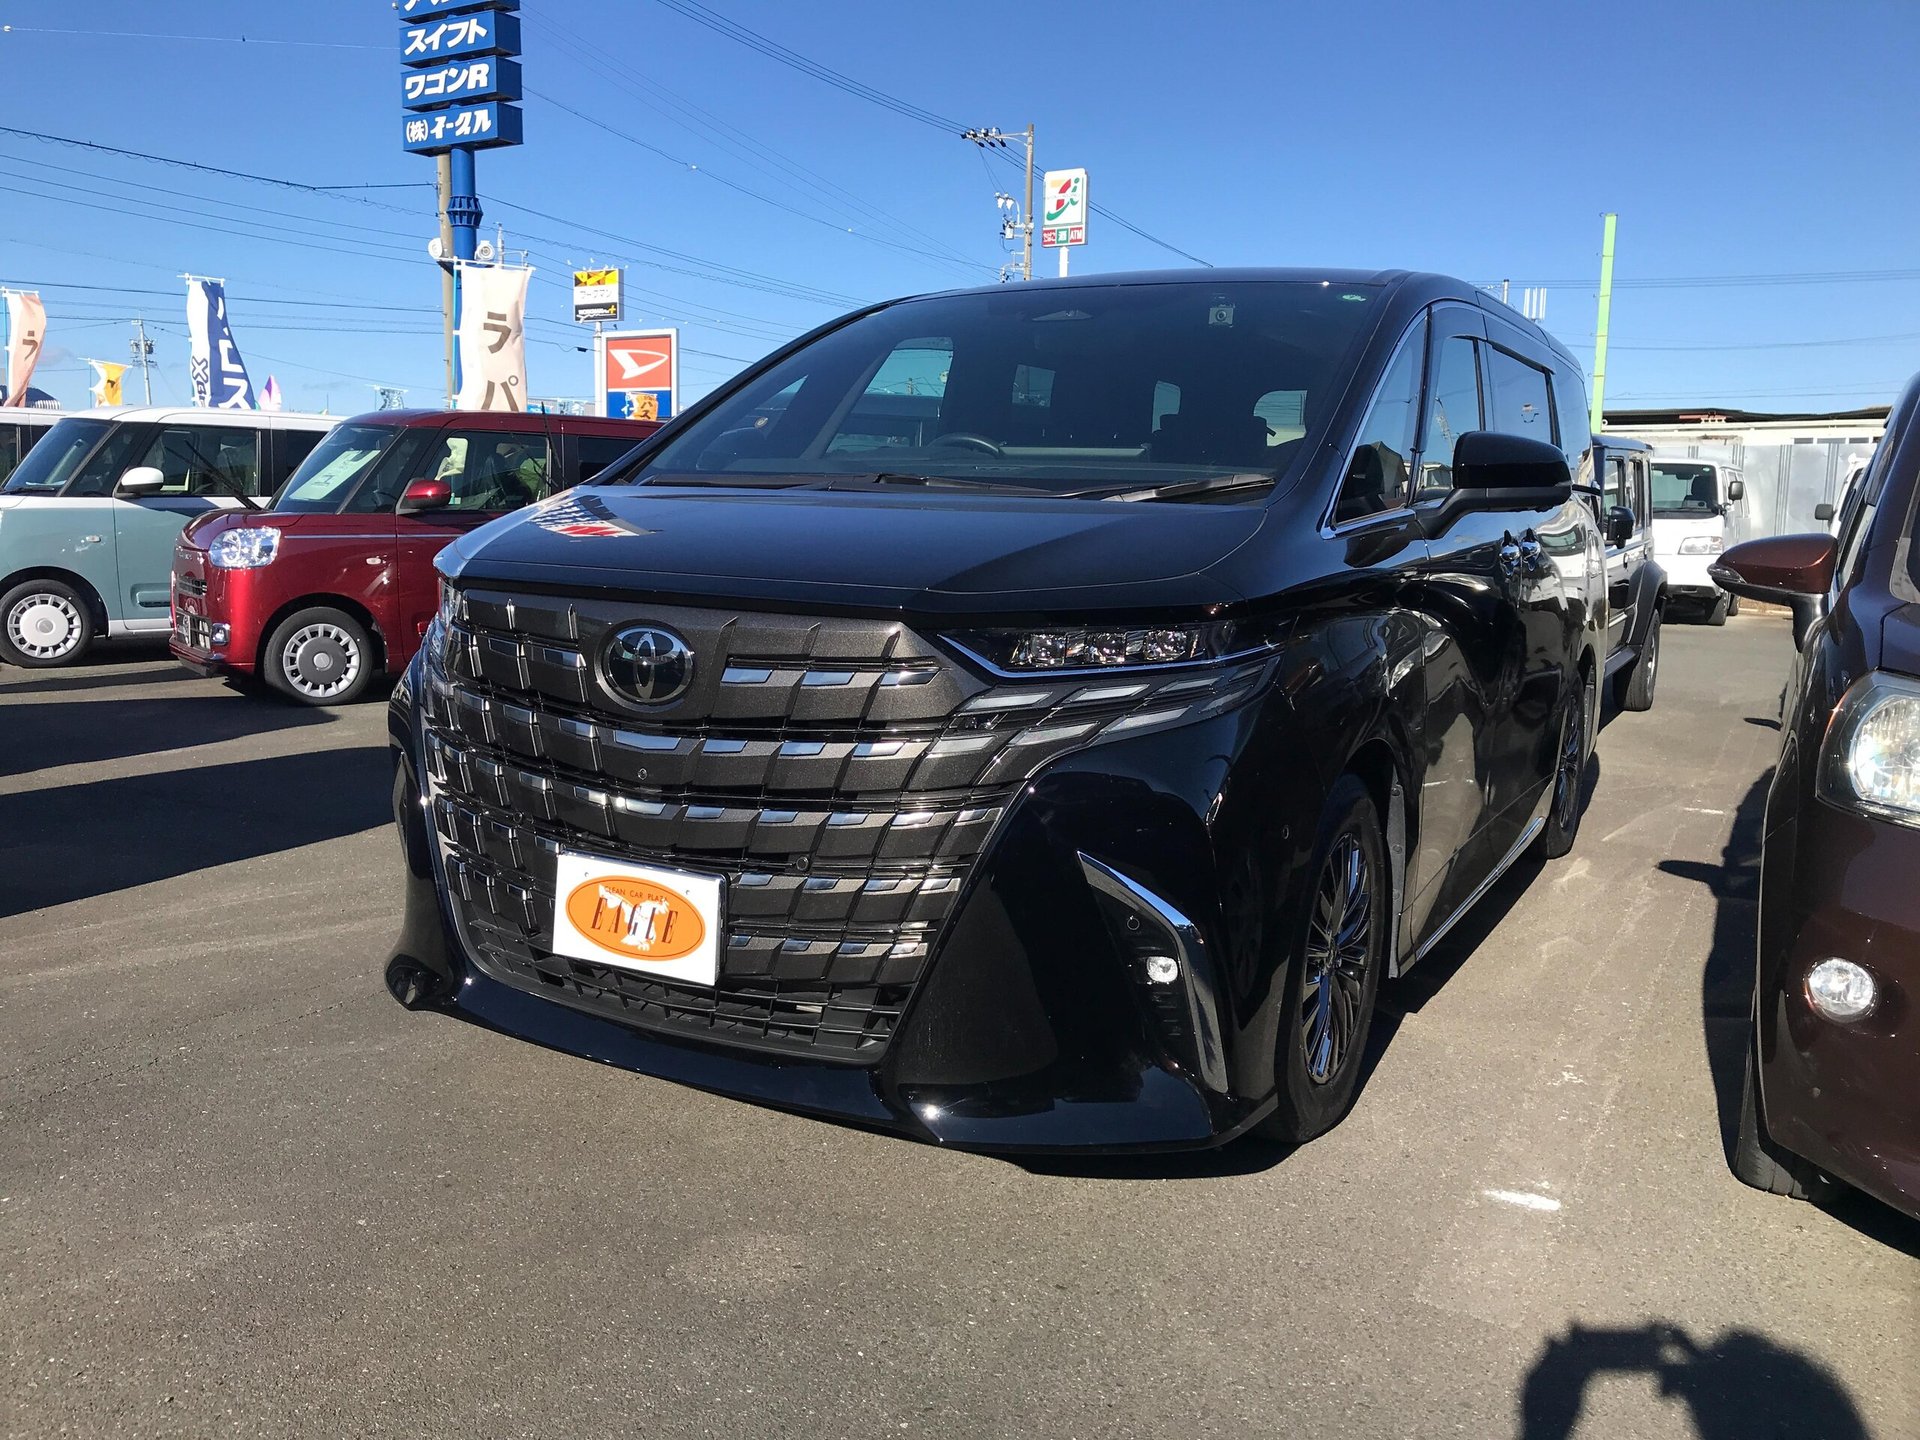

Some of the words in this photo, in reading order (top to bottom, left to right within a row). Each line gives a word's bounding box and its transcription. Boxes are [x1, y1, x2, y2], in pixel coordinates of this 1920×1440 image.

[404, 18, 487, 56] スイフト
[404, 63, 490, 100] ワゴンR
[604, 886, 626, 896] CLEAN
[629, 890, 643, 899] CAR
[647, 894, 668, 905] PLAZA
